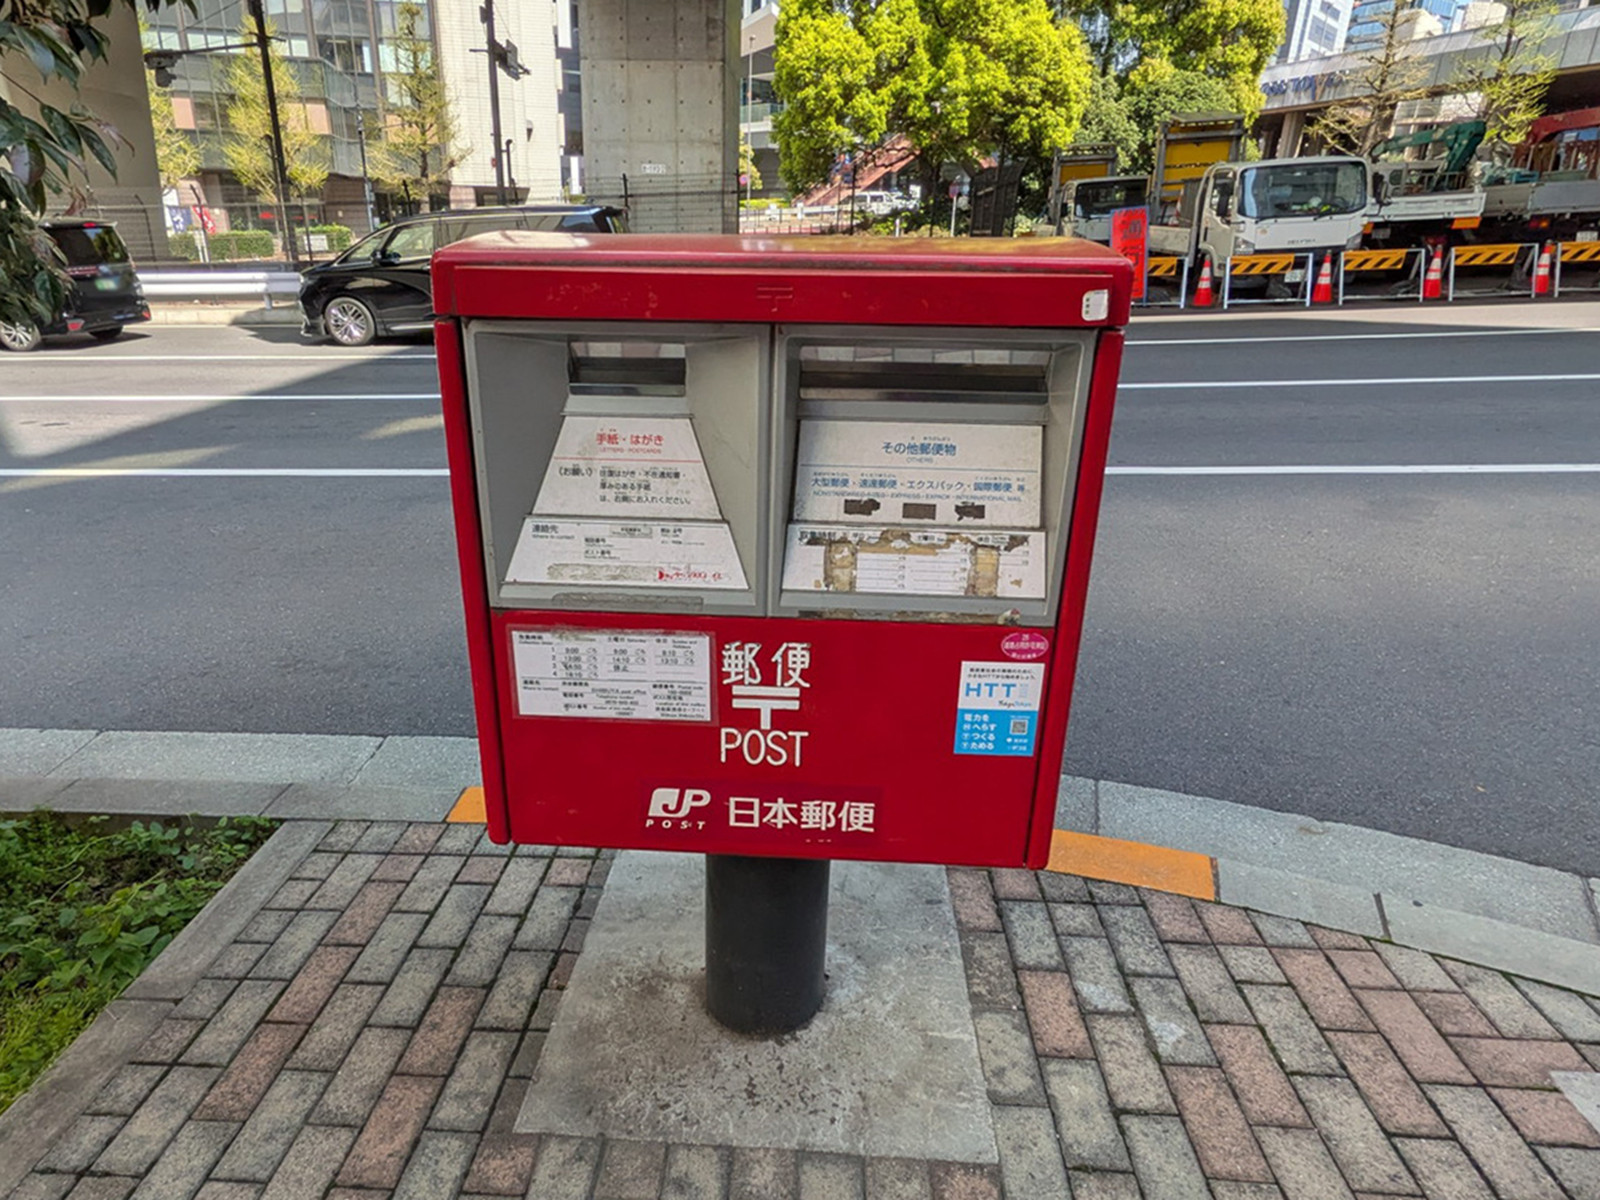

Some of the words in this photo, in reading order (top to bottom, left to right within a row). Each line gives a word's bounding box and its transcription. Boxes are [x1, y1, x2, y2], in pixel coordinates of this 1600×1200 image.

[596, 433, 664, 446] 手紙・はがき
[882, 442, 957, 456] その他郵便物
[721, 641, 811, 688] 郵便
[965, 683, 1017, 698] HTT
[720, 727, 809, 767] POST
[648, 787, 711, 818] JP
[645, 819, 706, 830] POST
[729, 796, 875, 833] 日本郵便
